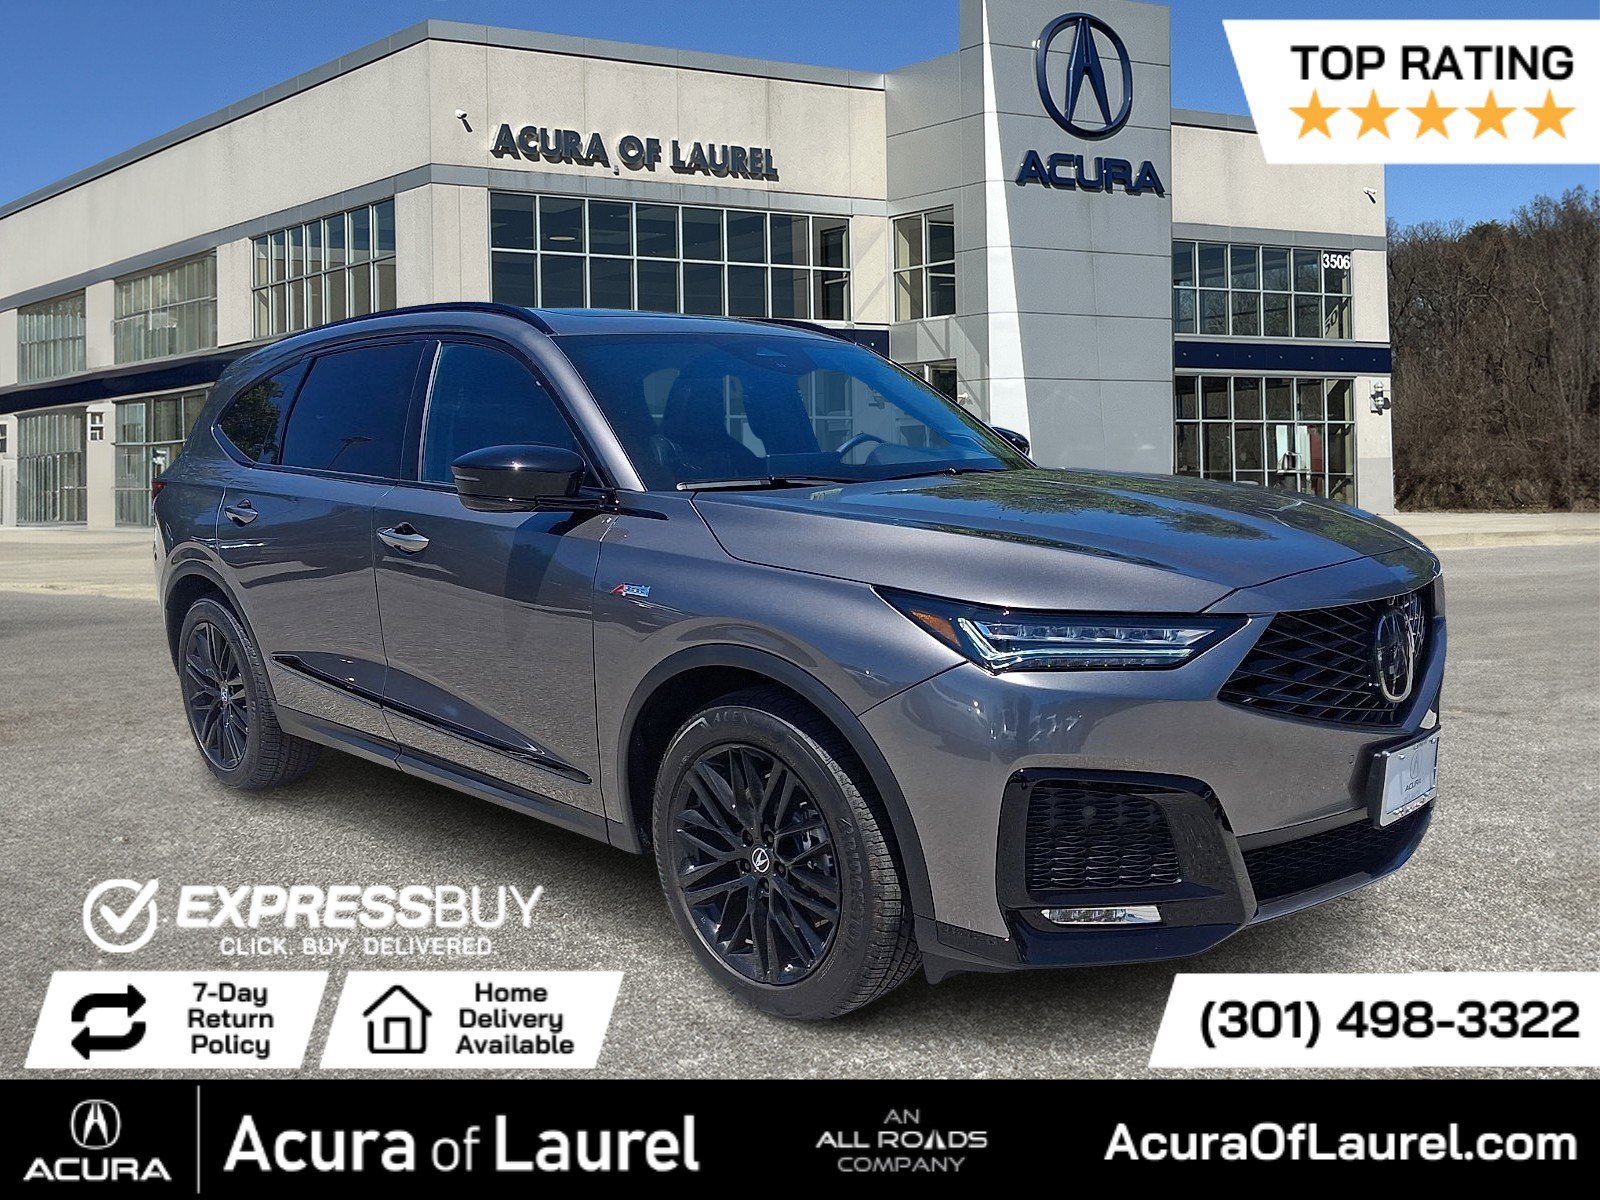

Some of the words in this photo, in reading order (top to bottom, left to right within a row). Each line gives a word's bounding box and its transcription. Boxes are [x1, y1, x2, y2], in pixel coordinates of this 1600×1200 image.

[491, 123, 611, 168] ACURA
[617, 135, 662, 172] OF
[670, 139, 780, 182] LAUREL
[1016, 149, 1166, 198] ACURA
[1322, 253, 1351, 270] 3506
